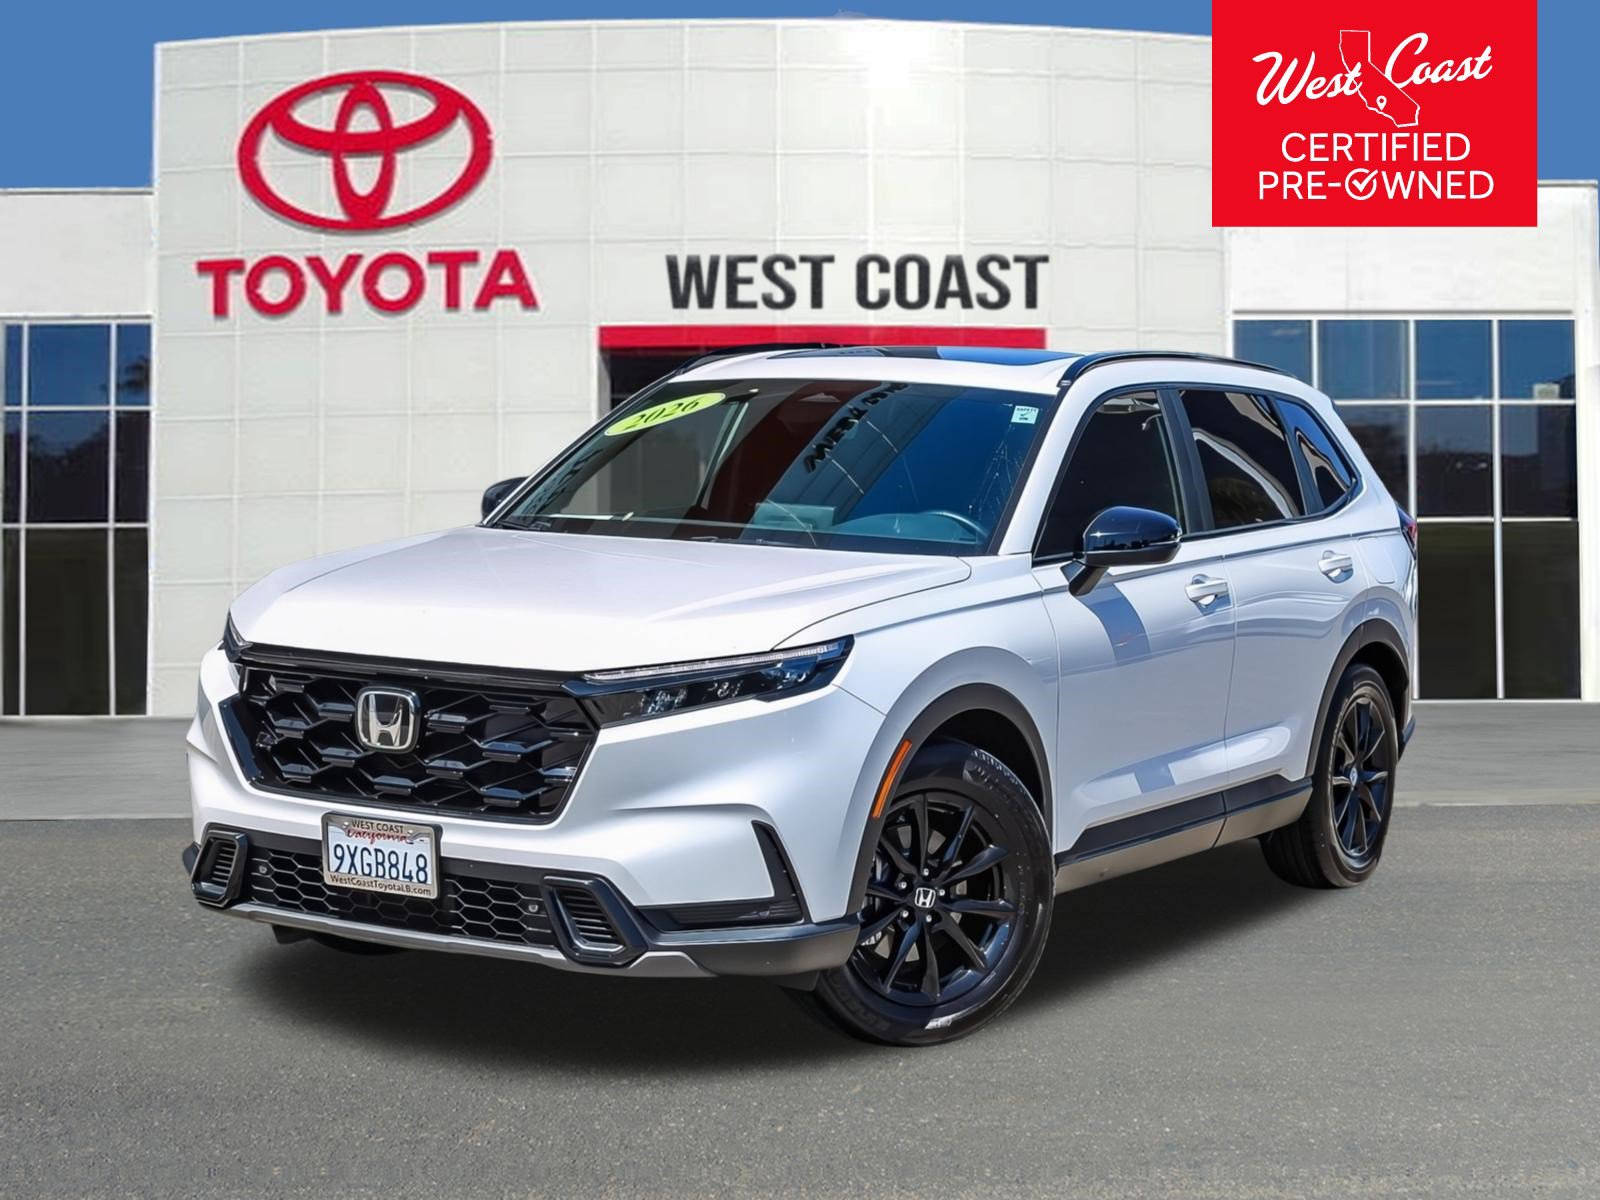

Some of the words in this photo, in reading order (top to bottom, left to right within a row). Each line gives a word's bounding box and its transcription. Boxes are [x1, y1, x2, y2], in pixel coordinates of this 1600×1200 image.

[196, 249, 538, 318] TOYOTA
[666, 254, 834, 310] WEST
[855, 254, 1050, 309] COAST
[623, 400, 700, 431] 2026
[352, 820, 375, 832] WEST
[376, 823, 404, 834] COAST
[333, 843, 428, 884] 9XGB848
[330, 874, 432, 896] WestCoastToyotaLB.com
